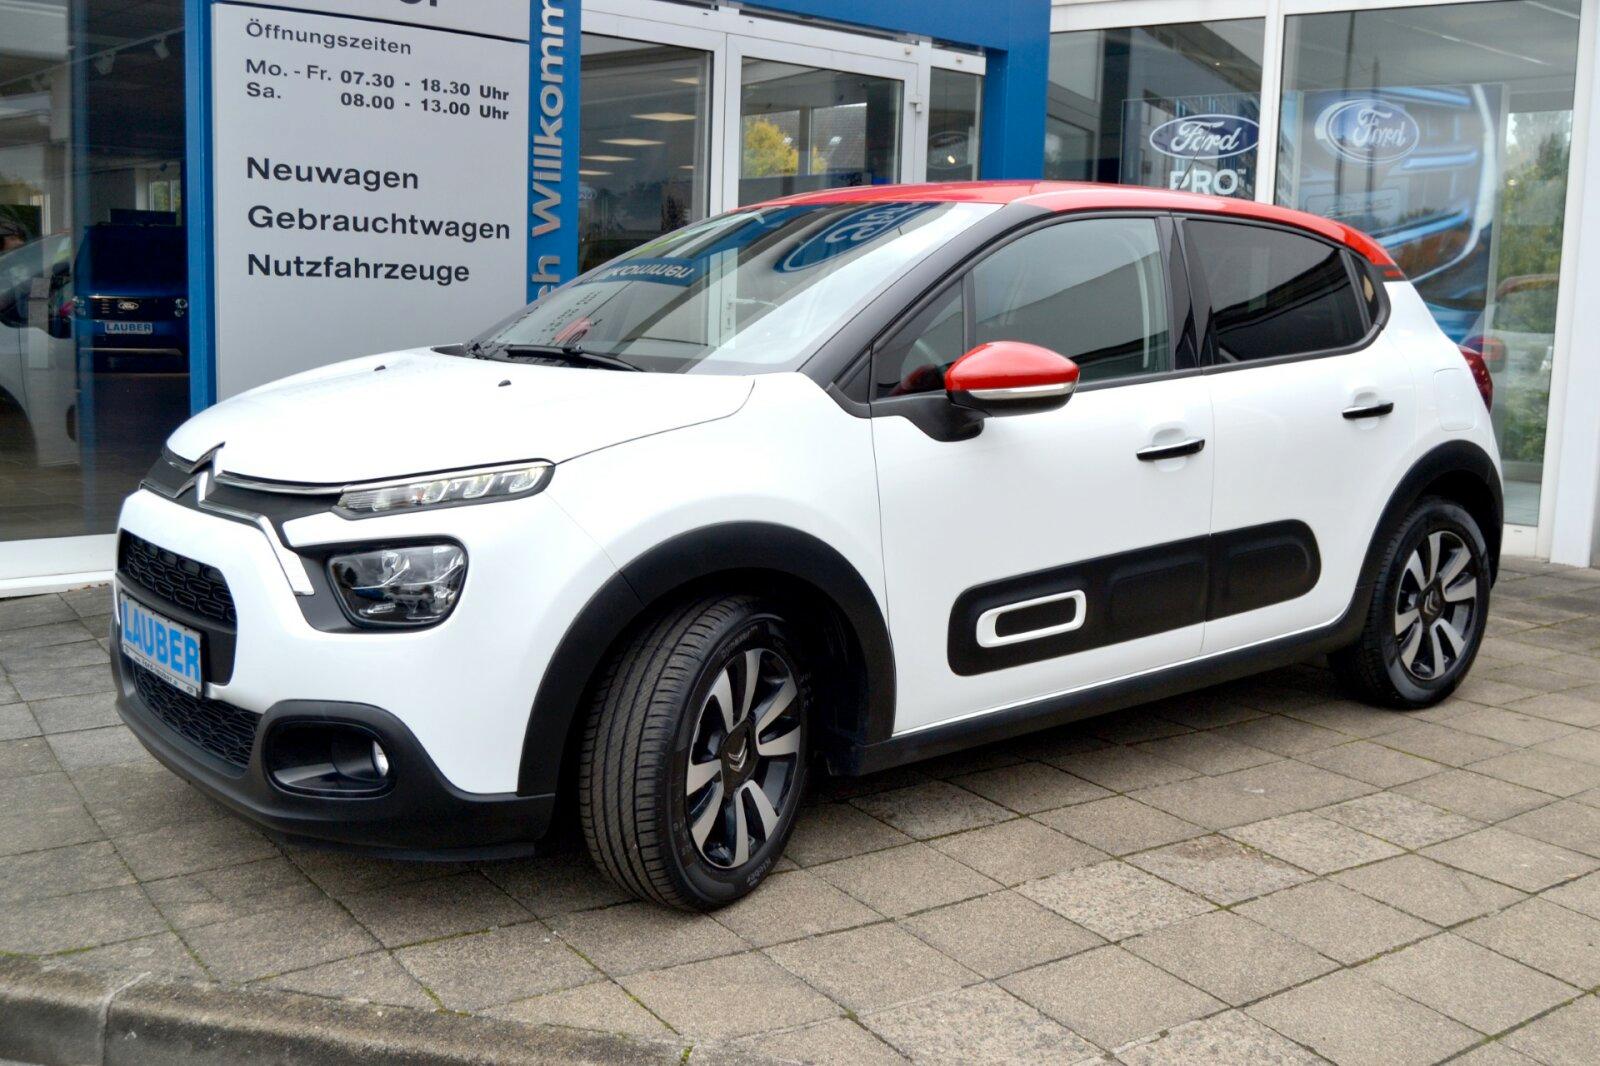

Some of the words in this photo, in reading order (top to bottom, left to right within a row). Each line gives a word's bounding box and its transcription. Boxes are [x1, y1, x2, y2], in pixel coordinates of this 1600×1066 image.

[245, 17, 411, 56] Öffnungszeiten
[245, 59, 288, 77] Mo.
[306, 64, 332, 82] Fr.
[340, 69, 395, 90] 07.30
[420, 78, 471, 97] 18.30
[479, 85, 510, 102] Uhr
[246, 81, 282, 100] Sa.
[340, 91, 395, 111] 08.00
[420, 98, 471, 117] 13.00
[479, 104, 510, 121] Uhr
[1170, 120, 1241, 152] Ford
[1353, 108, 1406, 148] Ford
[246, 156, 419, 191] Neuwagen
[247, 204, 510, 244] Gebrauchtwagen
[247, 253, 470, 287] Nutzfahrzeuge
[106, 323, 151, 332] LAUBER
[122, 600, 201, 684] LAUBER
